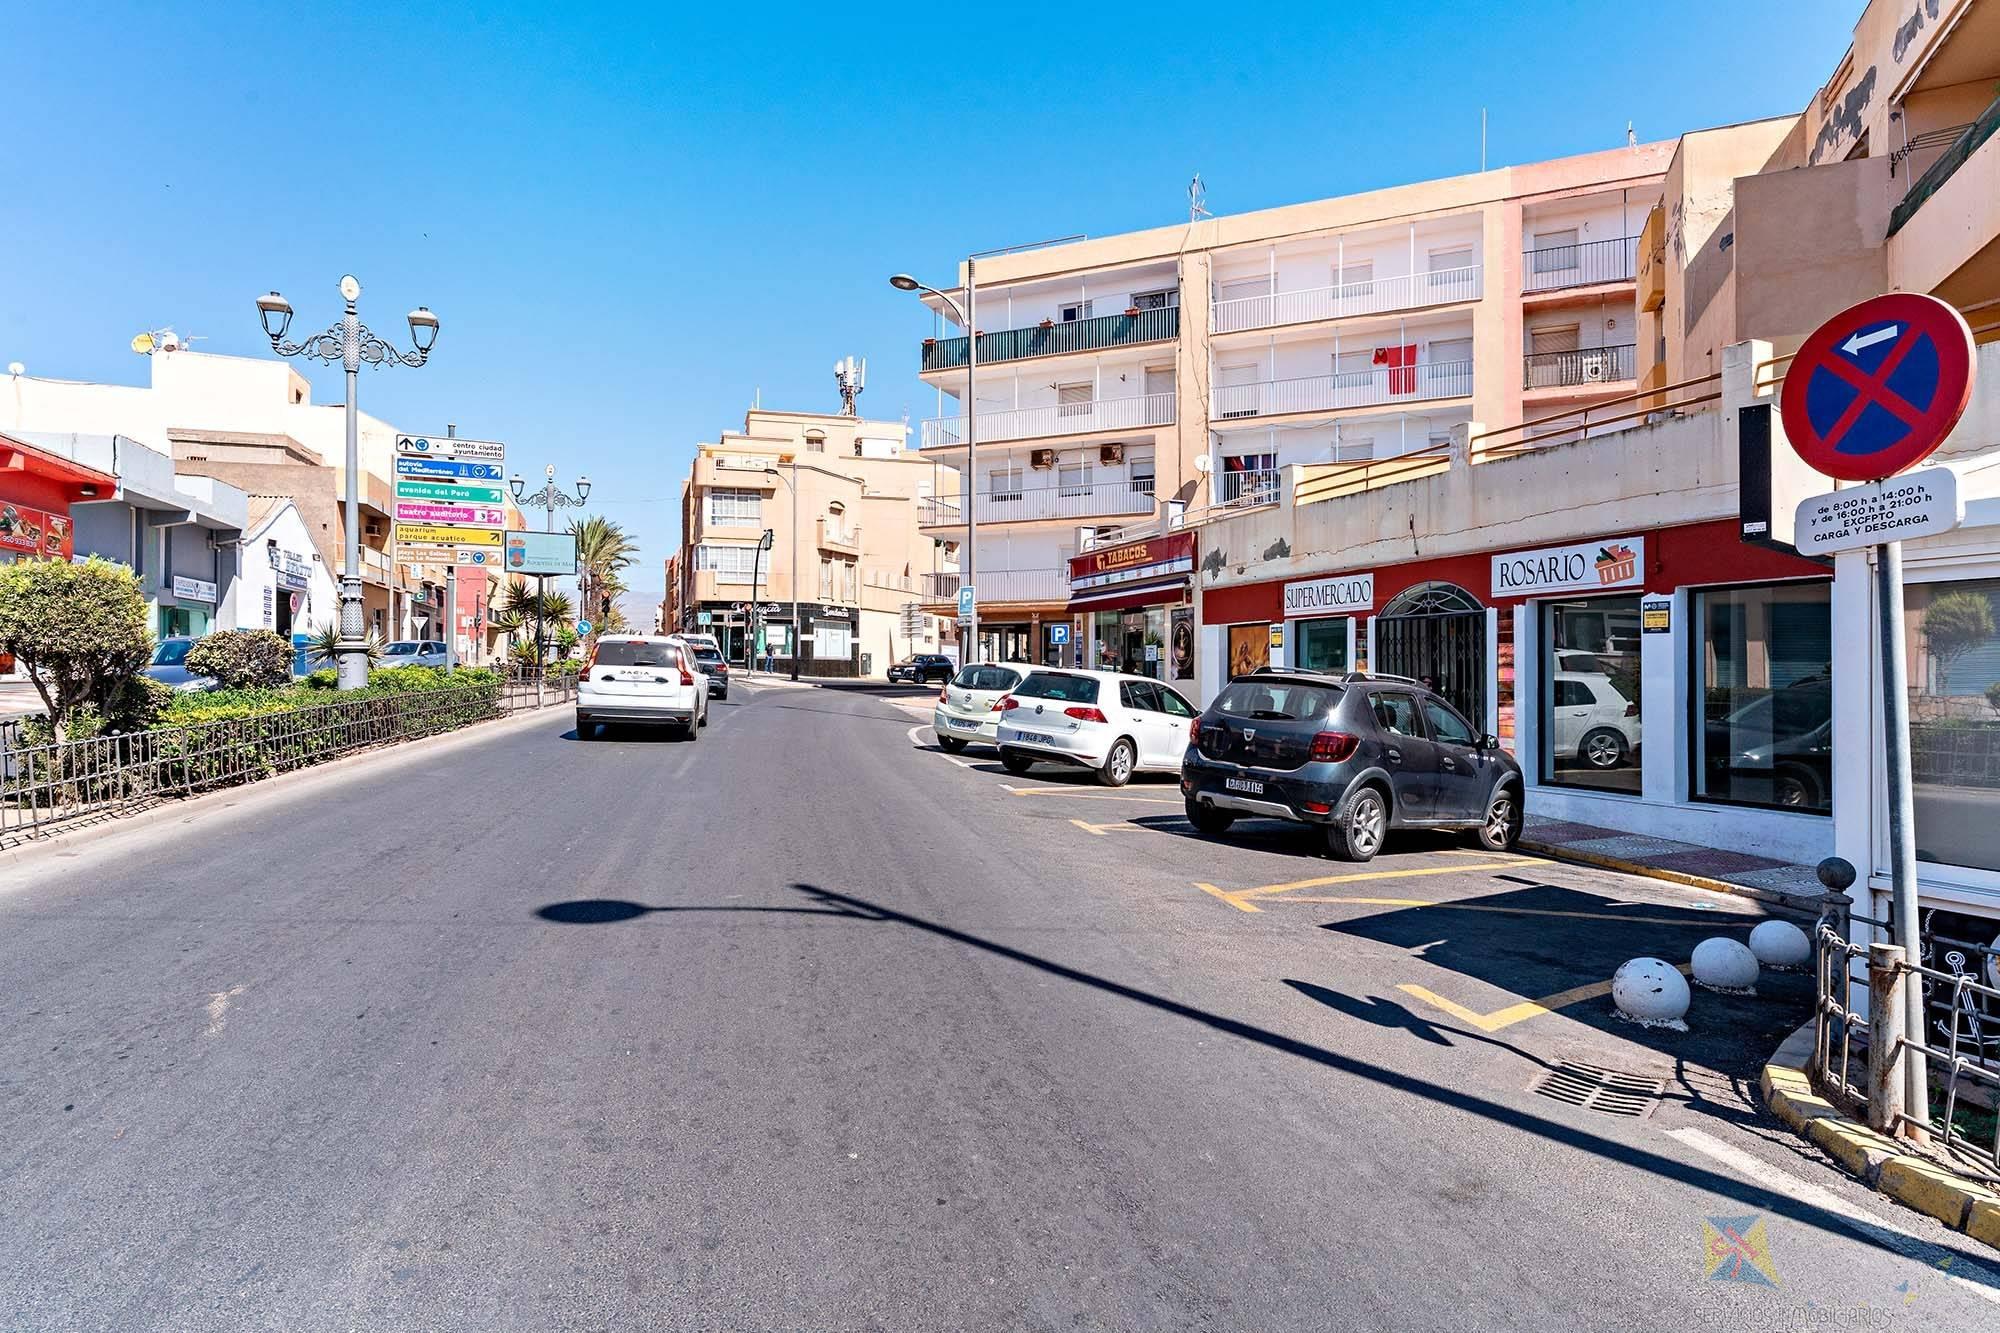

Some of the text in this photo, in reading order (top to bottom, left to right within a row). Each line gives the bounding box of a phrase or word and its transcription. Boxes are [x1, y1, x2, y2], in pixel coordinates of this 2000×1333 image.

[453, 442, 502, 452] centro ciudad
[454, 449, 502, 458] ayuntamiento
[451, 489, 470, 497] Perú
[1817, 507, 1829, 515] de
[1833, 499, 1858, 511] 8:00
[1861, 498, 1867, 506] h
[1882, 487, 1914, 501] 14:00
[1918, 485, 1925, 493] h
[400, 508, 468, 518] teatro auditorio
[1811, 518, 1817, 526] y
[1821, 515, 1833, 523] de
[1837, 507, 1865, 520] 16:00
[1869, 505, 1875, 513] h
[1889, 495, 1921, 509] 21:00
[399, 526, 437, 534] aquarium
[1814, 514, 1929, 542] CARGA Y DESCARGA
[399, 533, 427, 541] parque
[1107, 544, 1147, 564] TABACOS
[1500, 553, 1586, 587] ROSARIO
[963, 591, 972, 604] P
[1286, 580, 1372, 609] SUPERMERCADO
[1054, 627, 1066, 642] P
